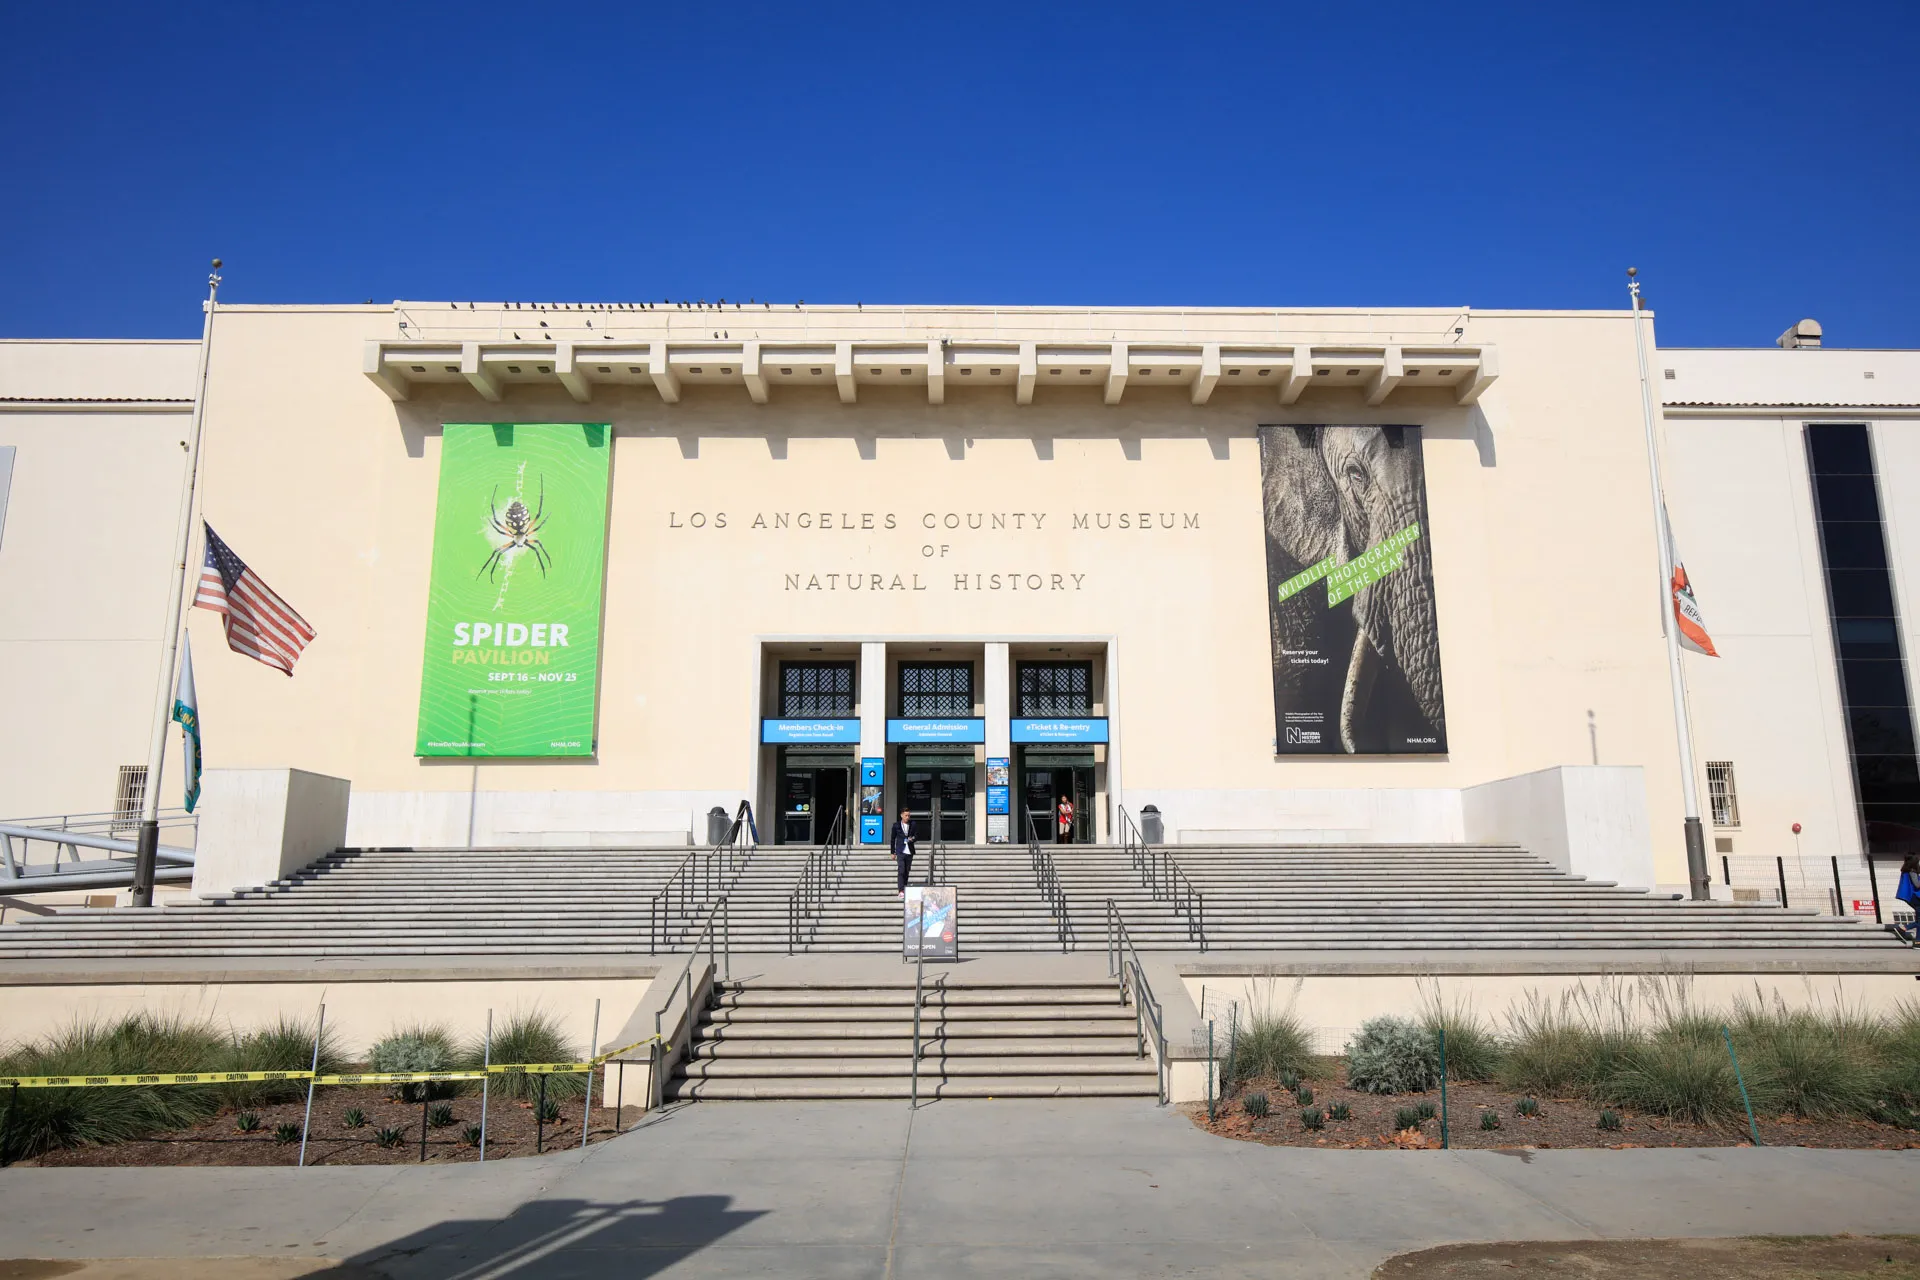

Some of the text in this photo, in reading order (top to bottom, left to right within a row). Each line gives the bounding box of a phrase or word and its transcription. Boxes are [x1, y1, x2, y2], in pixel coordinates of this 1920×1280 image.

[669, 512, 1200, 530] LOS ANGELES COUNTY MUSEUM
[921, 545, 950, 558] OF
[1327, 525, 1420, 588] PHOTOGRAPHER
[784, 574, 1085, 591] NATURAL HISTORY
[1278, 556, 1336, 598] WILDLIFE
[1328, 552, 1404, 605] OF THE YEAR
[453, 622, 569, 647] SPIDER
[452, 649, 550, 665] PAVILION
[488, 672, 514, 682] SEPT
[517, 673, 528, 681] 16
[538, 673, 562, 682] NOV
[565, 673, 577, 682] 25
[1060, 724, 1090, 732] Re-entry
[552, 1064, 574, 1072] CAUTION
[47, 1077, 70, 1086] CAUTION
[85, 1077, 109, 1085] CUIDADO
[137, 1075, 160, 1083] CAUTION
[175, 1075, 198, 1083] CUIDADO
[226, 1073, 249, 1081] CAUTION
